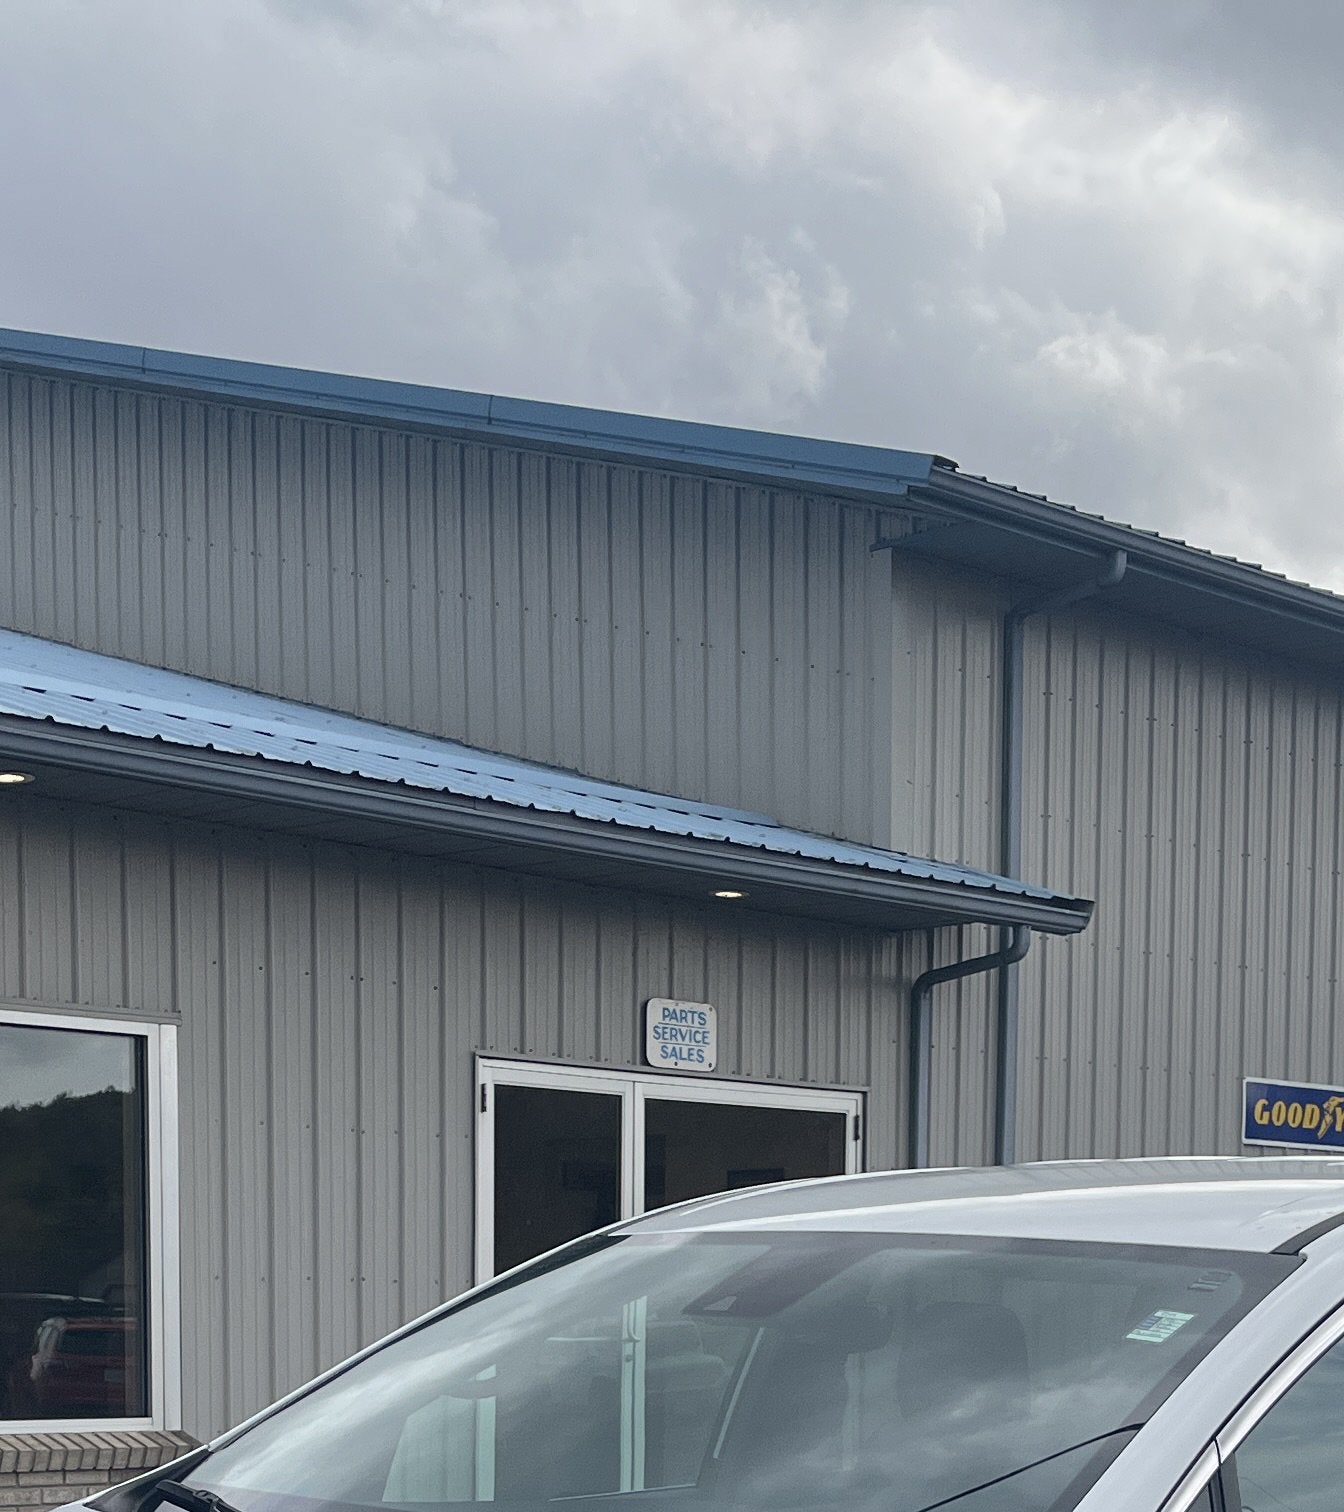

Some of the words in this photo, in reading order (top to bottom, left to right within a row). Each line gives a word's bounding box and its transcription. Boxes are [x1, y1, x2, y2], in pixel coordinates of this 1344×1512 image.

[662, 1007, 707, 1026] PARTS
[652, 1025, 710, 1045] SERVICE
[660, 1045, 705, 1063] SALES
